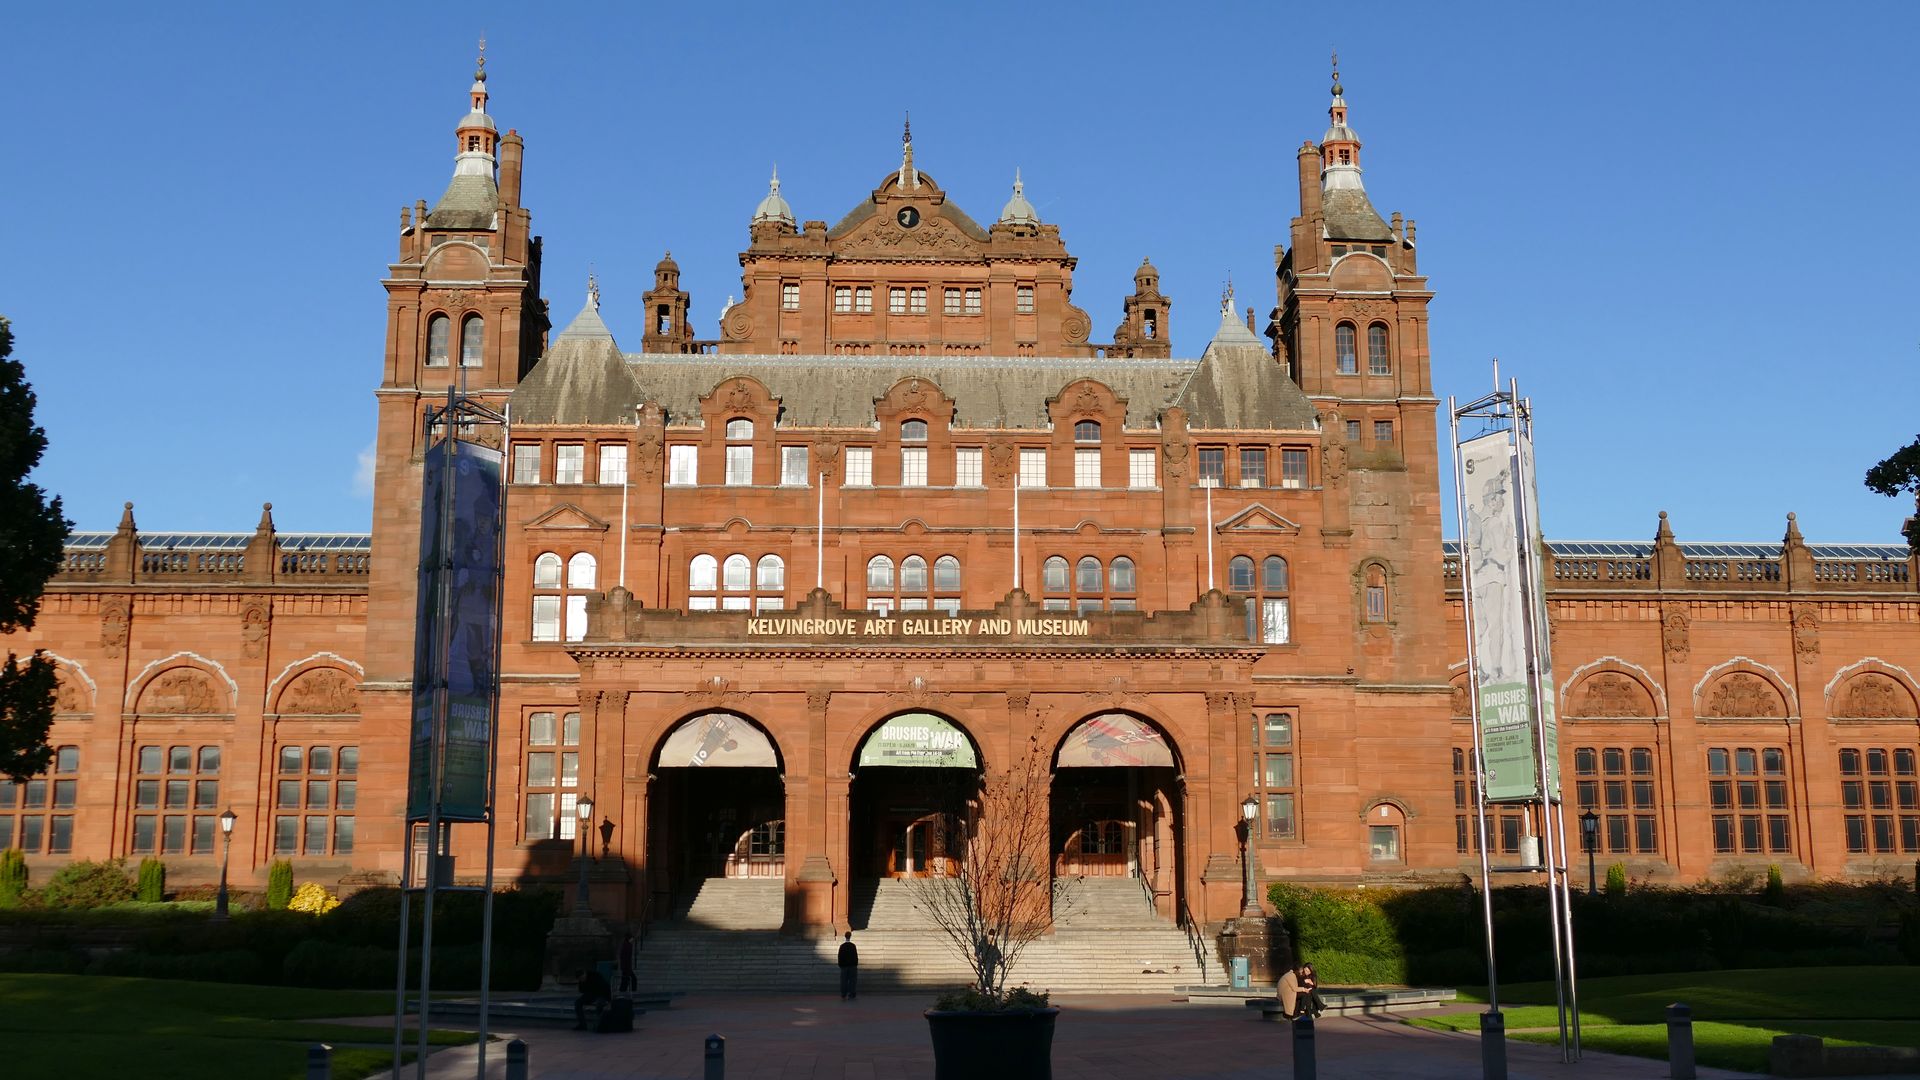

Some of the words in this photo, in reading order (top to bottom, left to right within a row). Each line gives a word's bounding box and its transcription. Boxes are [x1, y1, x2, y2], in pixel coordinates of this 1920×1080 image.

[748, 619, 857, 635] KELVINGROVE
[864, 619, 896, 635] ART
[903, 619, 972, 635] GALLERY
[978, 619, 1011, 635] AND
[1017, 619, 1088, 636] MUSEUM
[1484, 688, 1527, 708] BRUSHES
[452, 703, 490, 721] BRUSHES
[1498, 704, 1528, 724] WAR
[464, 720, 489, 741] WAR
[882, 726, 929, 741] BRUSHES
[931, 731, 963, 749] WAR
